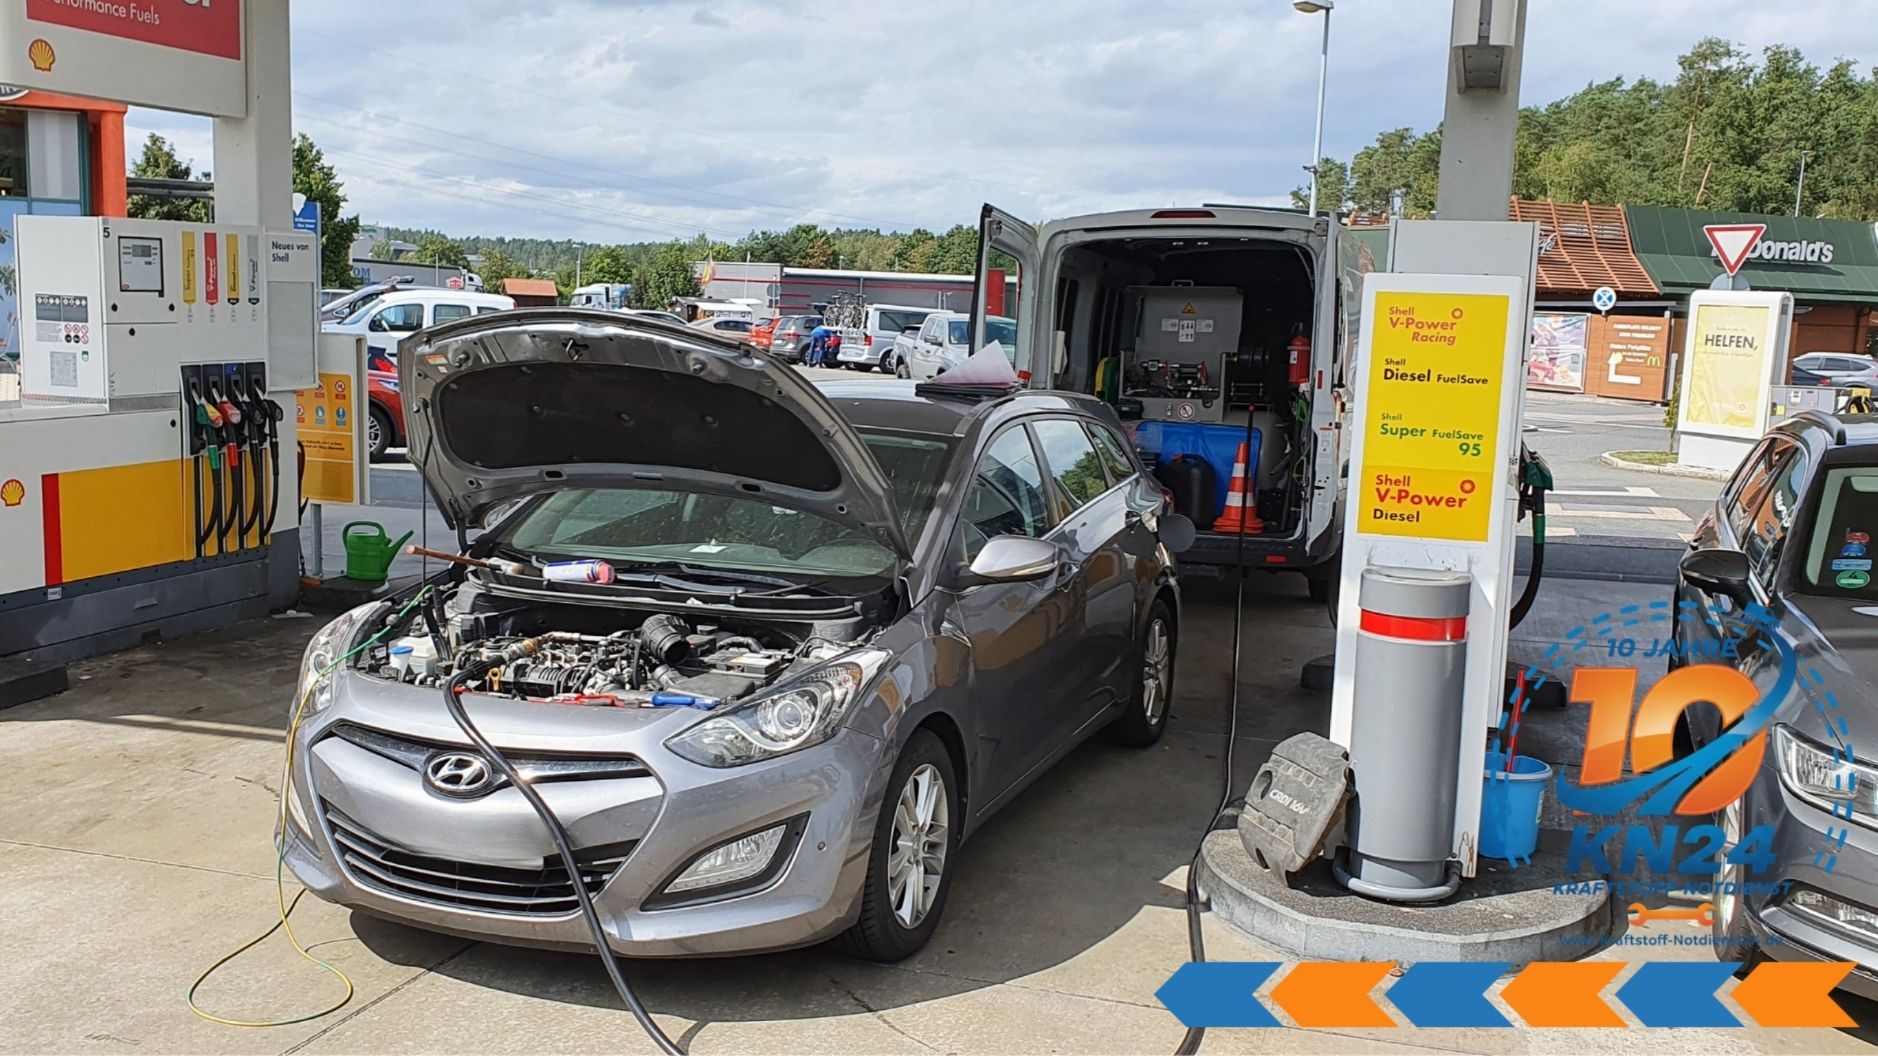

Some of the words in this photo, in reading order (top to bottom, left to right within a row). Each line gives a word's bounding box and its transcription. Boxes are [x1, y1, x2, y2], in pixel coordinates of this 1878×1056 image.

[53, 0, 126, 18] ormance
[130, 3, 160, 25] Fuels
[103, 227, 110, 238] 5
[272, 241, 294, 250] Neues
[1711, 239, 1834, 263] Donald's
[272, 252, 289, 262] Shell
[1389, 306, 1414, 316] Shell
[1389, 317, 1457, 331] V-Power
[1411, 332, 1456, 346] Racing
[1704, 333, 1758, 351] HELFEN,
[1384, 358, 1406, 366] Shell
[1383, 368, 1431, 382] Diesel
[1436, 373, 1488, 385] FuelSave
[1381, 413, 1402, 421] Shell
[1380, 423, 1426, 439] Super
[1432, 429, 1483, 441] FuelSave
[1458, 442, 1481, 457] 95
[1375, 474, 1411, 487] Shell
[1375, 487, 1467, 508] V-Power
[1373, 508, 1420, 523] Diesel
[1289, 800, 1310, 815] 16V
